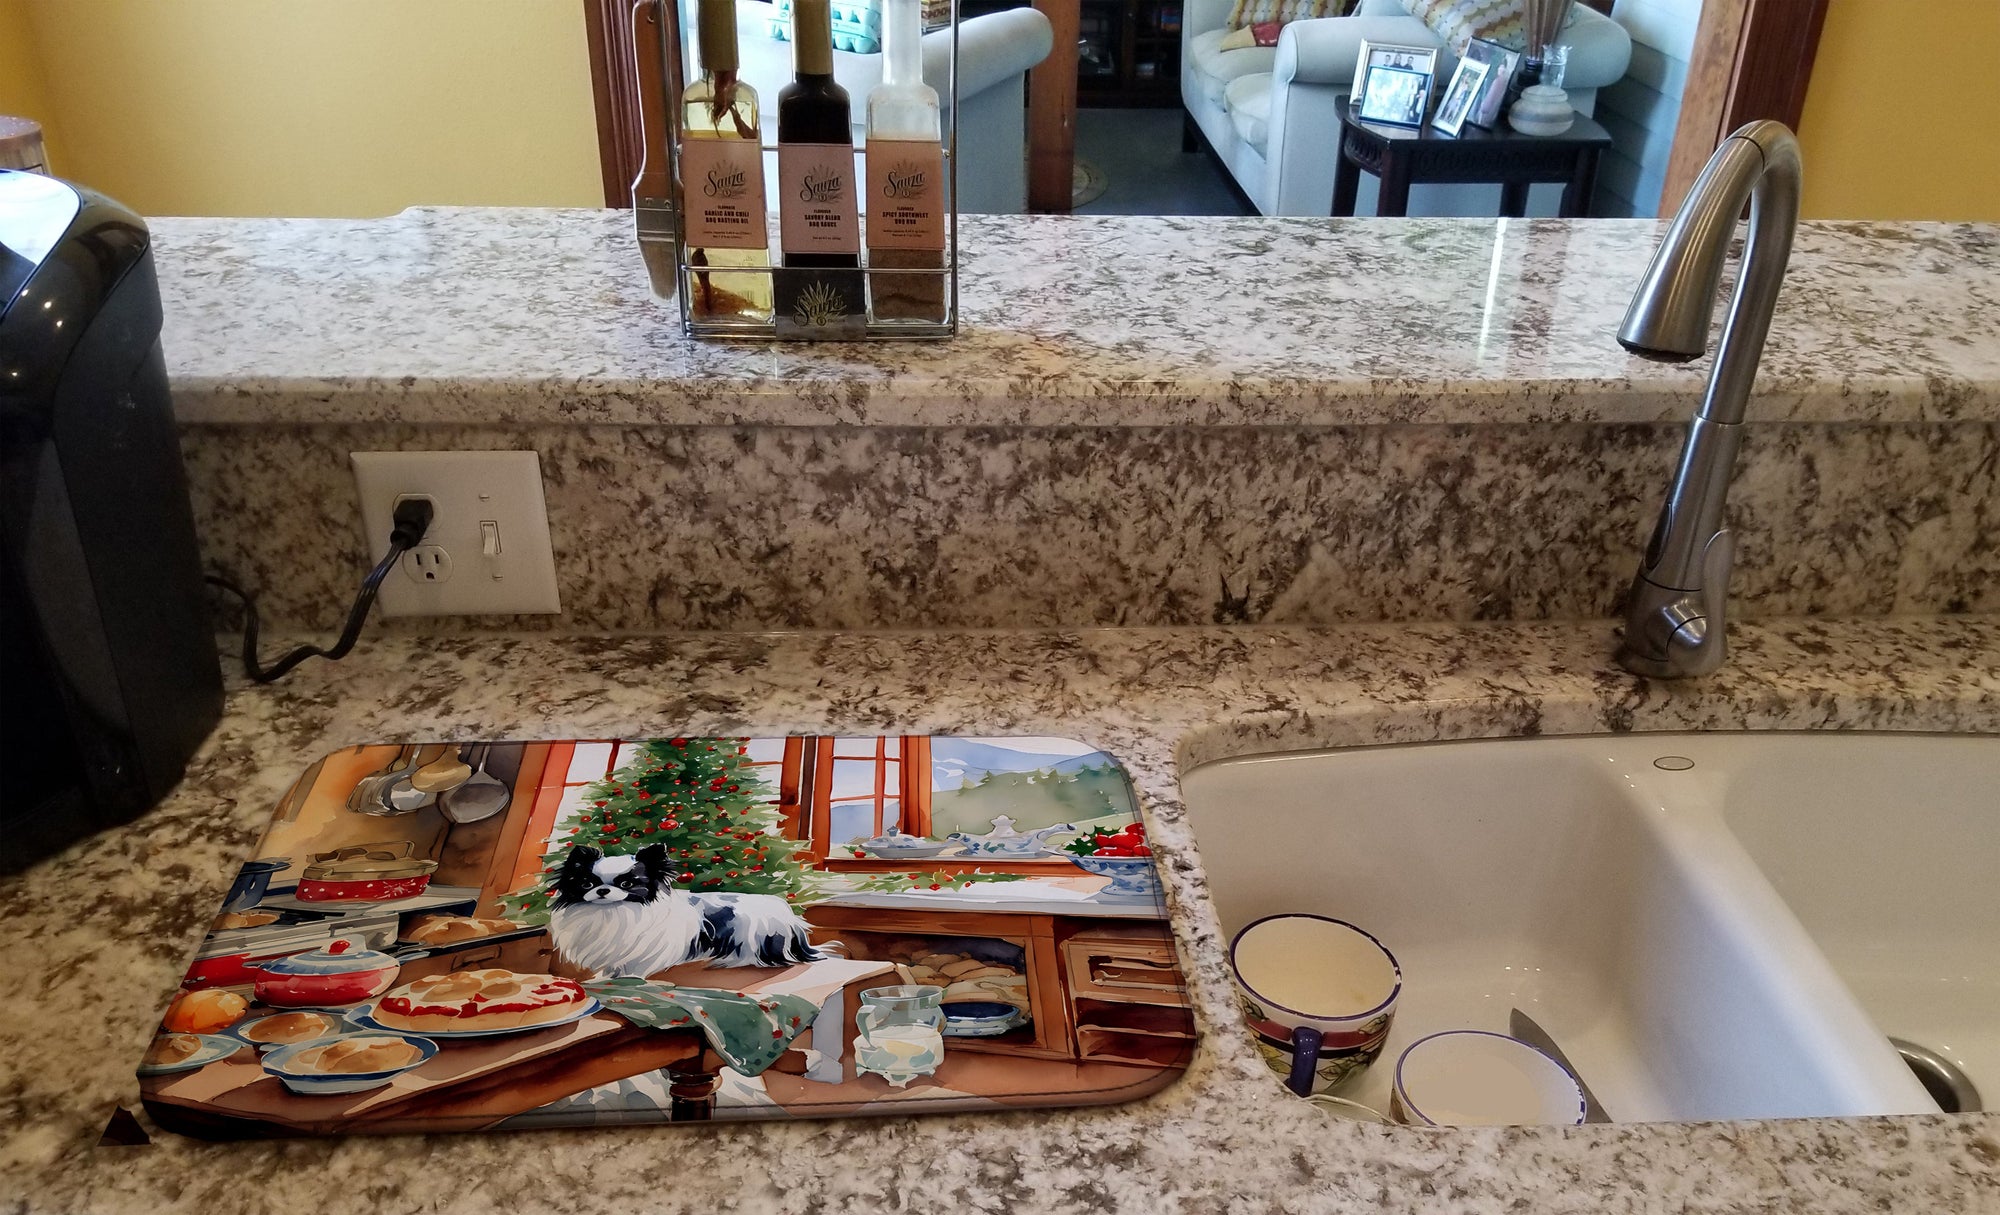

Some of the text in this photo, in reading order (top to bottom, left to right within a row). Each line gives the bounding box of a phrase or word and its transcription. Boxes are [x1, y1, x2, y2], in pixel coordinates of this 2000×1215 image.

[704, 170, 745, 197] Sauza
[800, 175, 842, 202] Sauza
[884, 171, 926, 198] Sauza
